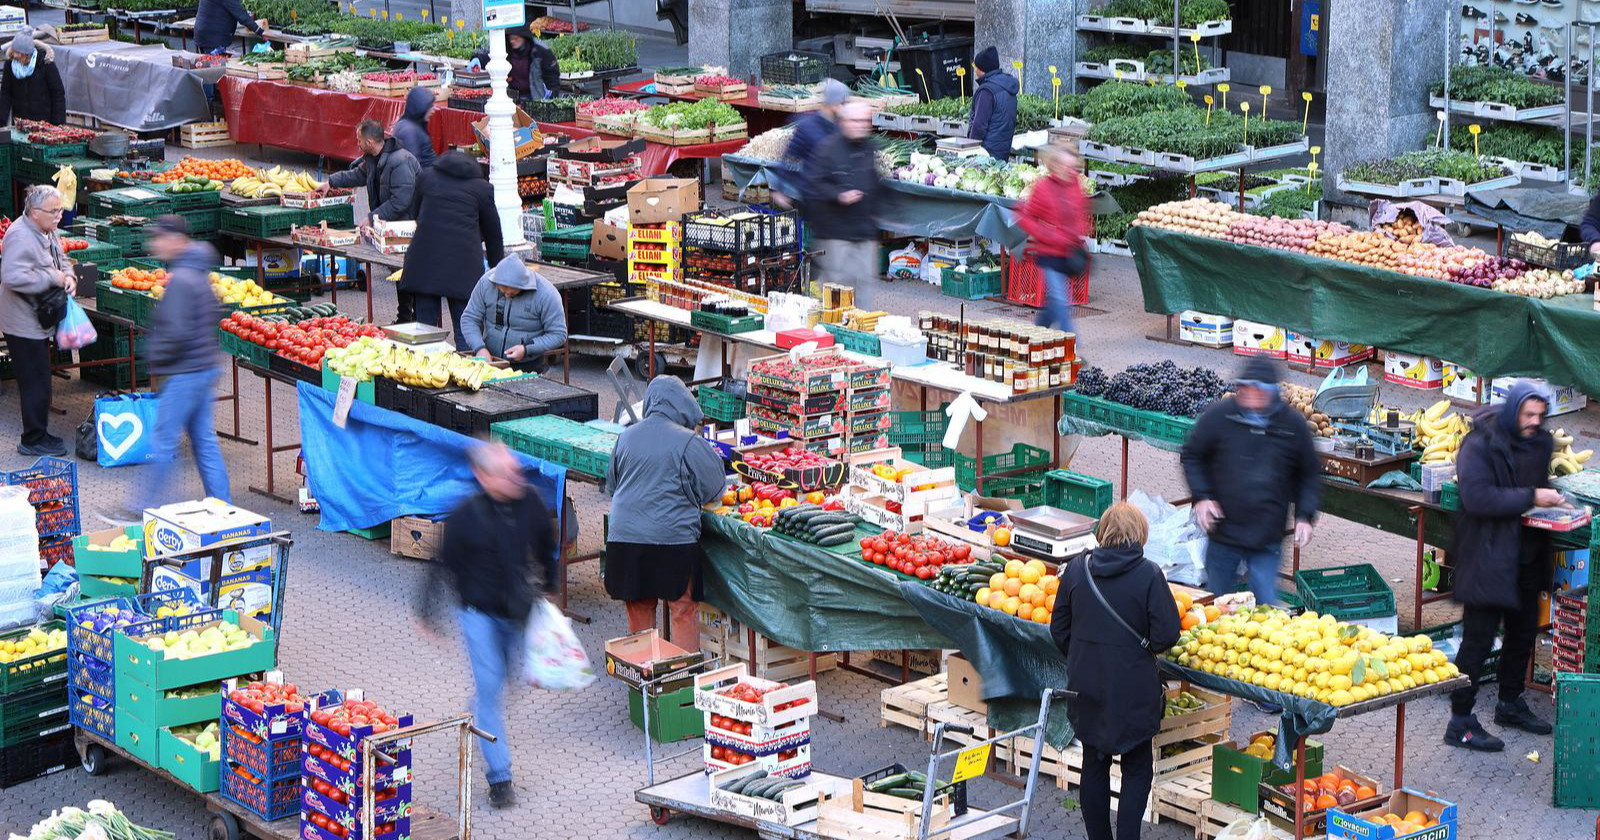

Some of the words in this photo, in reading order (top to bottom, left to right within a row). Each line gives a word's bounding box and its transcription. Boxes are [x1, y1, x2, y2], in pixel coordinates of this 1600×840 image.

[637, 229, 662, 240] ELIANI
[637, 250, 662, 261] ELIANI
[762, 376, 784, 388] DELUXE
[851, 379, 873, 389] DELUXE
[809, 384, 830, 393] DELUXE
[761, 397, 773, 407] Lux
[851, 401, 873, 410] DELUXE
[760, 420, 780, 430] DELUXE
[852, 423, 874, 433] DELUXE
[805, 427, 827, 437] DELUXE
[157, 527, 183, 551] derby
[221, 528, 252, 541] BANANAS
[221, 574, 251, 587] BANANAS
